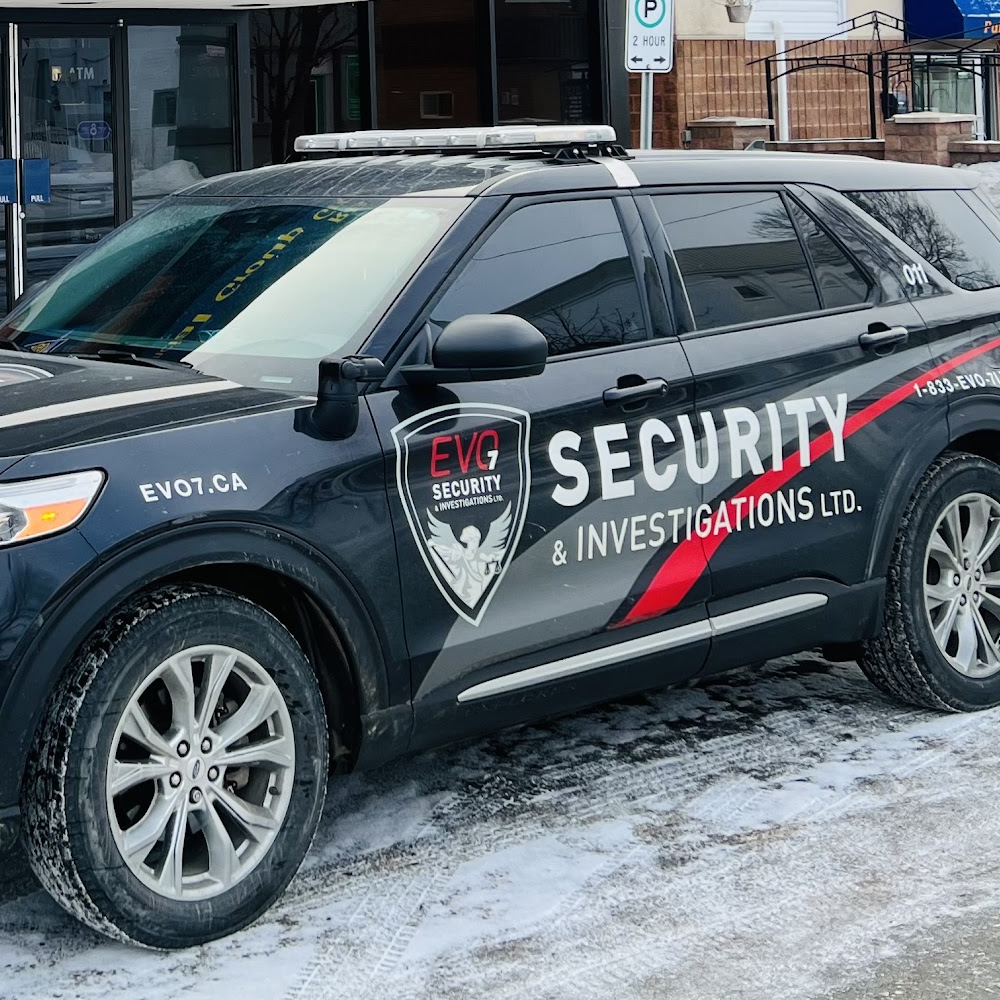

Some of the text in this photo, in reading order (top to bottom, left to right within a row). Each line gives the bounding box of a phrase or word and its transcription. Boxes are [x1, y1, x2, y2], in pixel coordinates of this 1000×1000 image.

[632, 35, 666, 46] 2 HOUR
[902, 263, 929, 286] 011
[548, 393, 848, 507] SECURITY
[139, 472, 248, 503] EVO7.CA
[432, 474, 501, 501] SECURITY
[439, 494, 494, 512] INVESTIGATIONS
[551, 486, 863, 566] & INVESTIGATIONS LTD.
